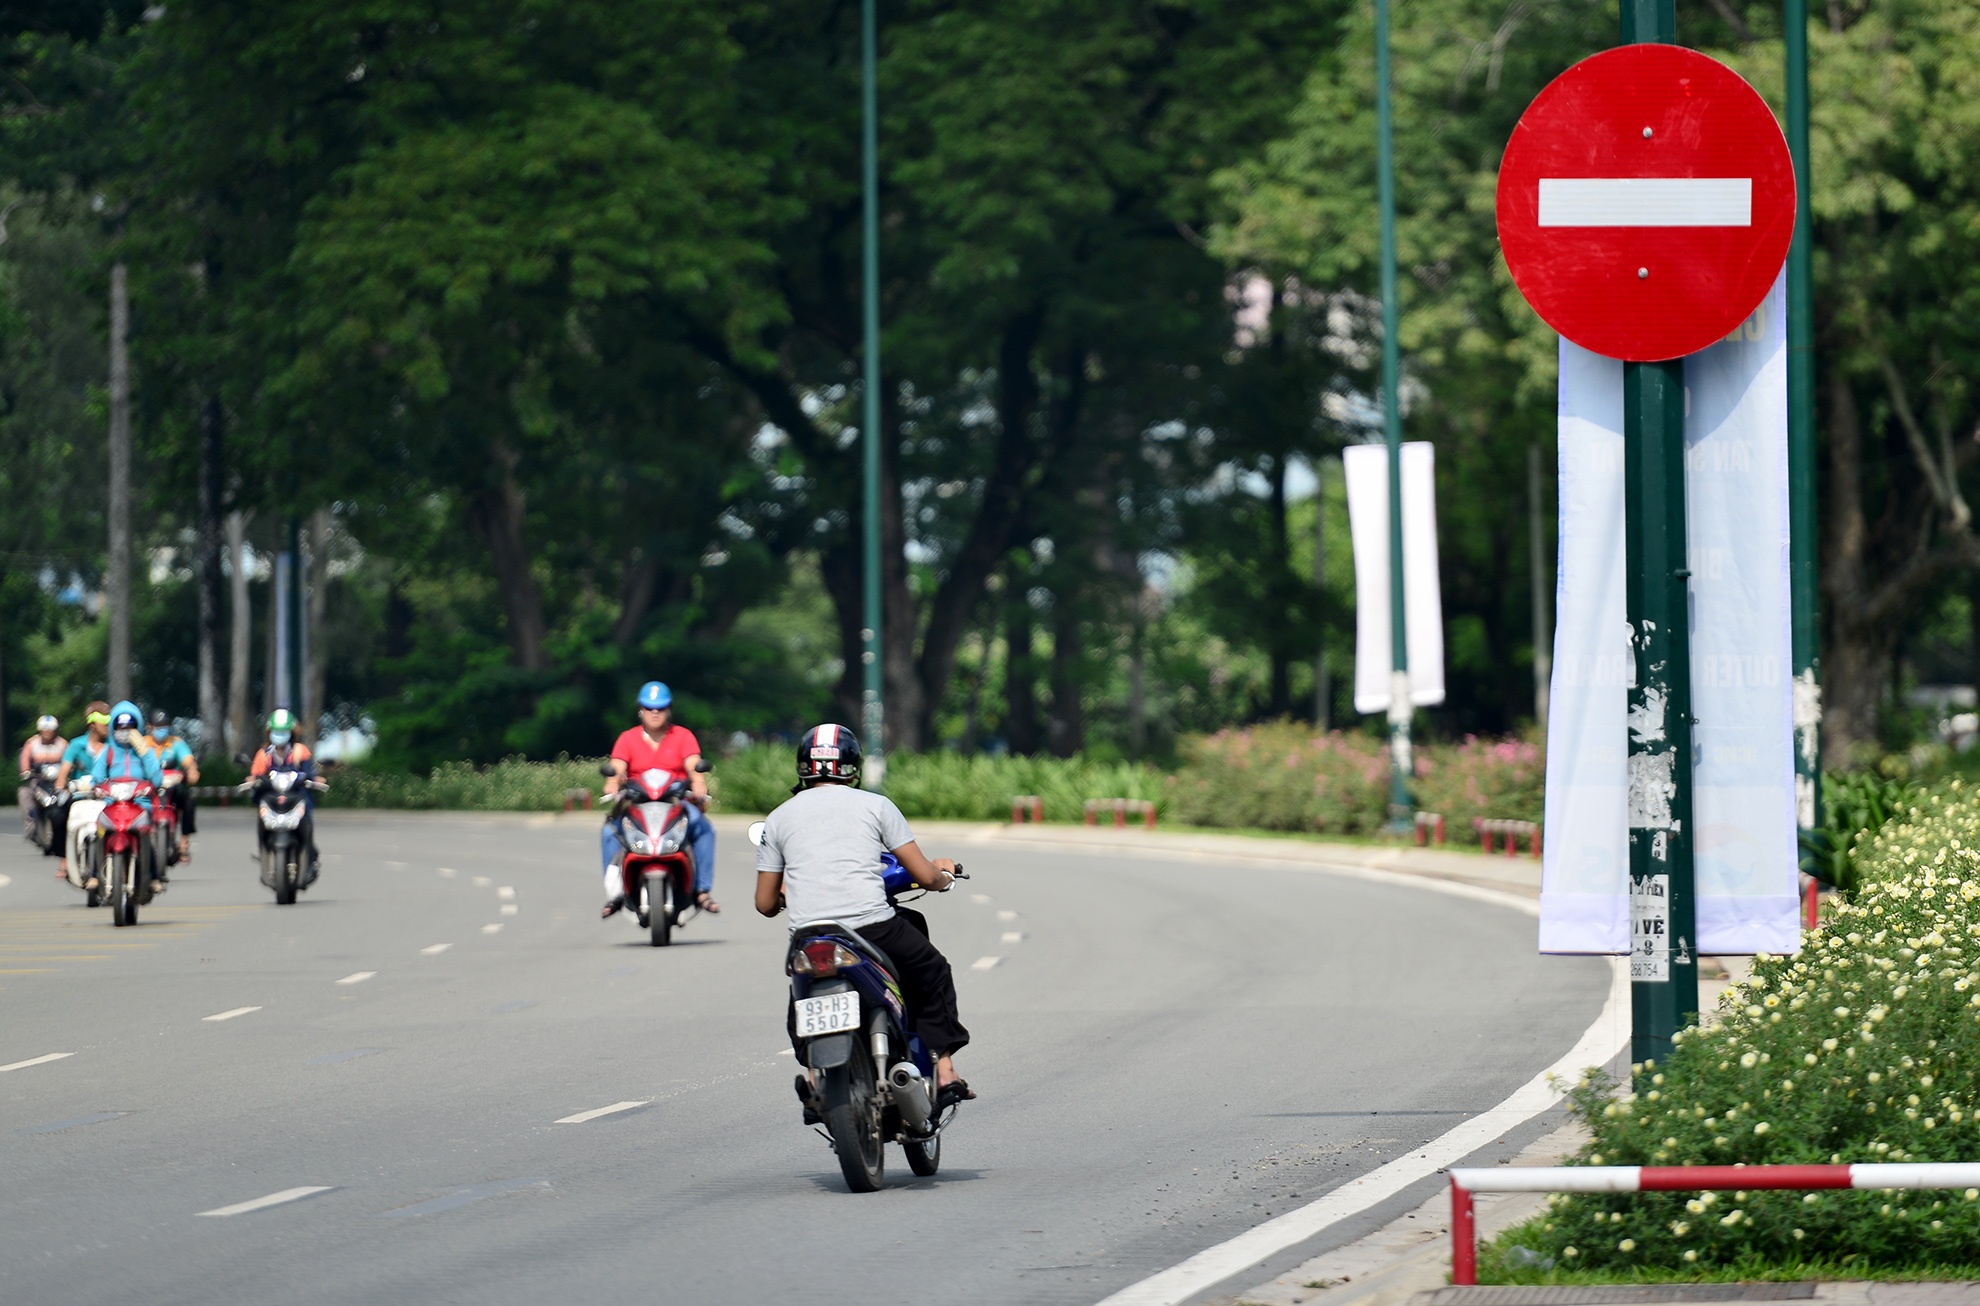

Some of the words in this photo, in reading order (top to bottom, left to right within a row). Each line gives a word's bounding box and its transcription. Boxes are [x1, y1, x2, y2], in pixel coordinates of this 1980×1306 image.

[1642, 914, 1665, 939] VỆ
[806, 996, 850, 1017] 93-H3
[806, 1012, 850, 1033] 5502
